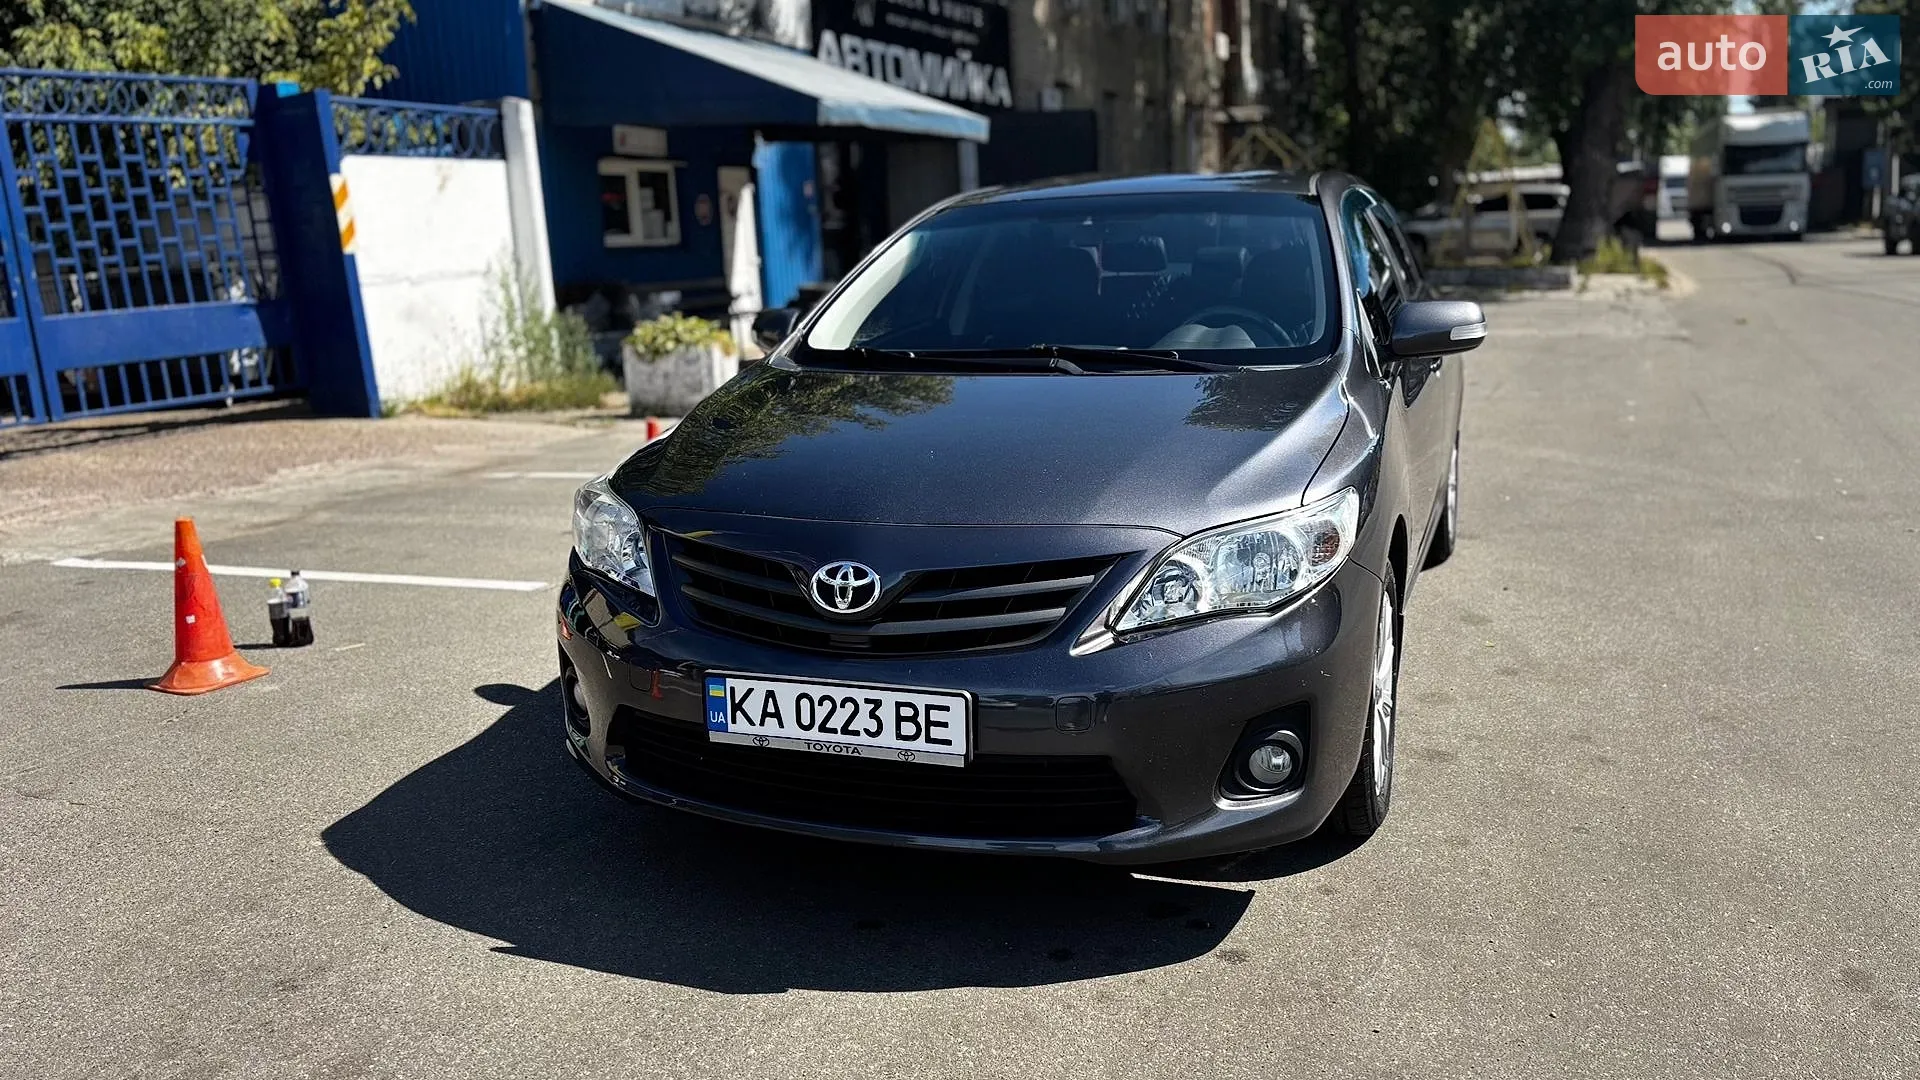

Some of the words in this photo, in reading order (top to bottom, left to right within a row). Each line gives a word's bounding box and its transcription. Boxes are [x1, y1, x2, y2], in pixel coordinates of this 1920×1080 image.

[818, 28, 1012, 108] АВТОМИЙКА
[709, 711, 726, 724] UA
[729, 686, 784, 729] KA
[795, 692, 884, 738] 0223
[895, 700, 952, 747] BE
[804, 741, 861, 755] TOYOTA
